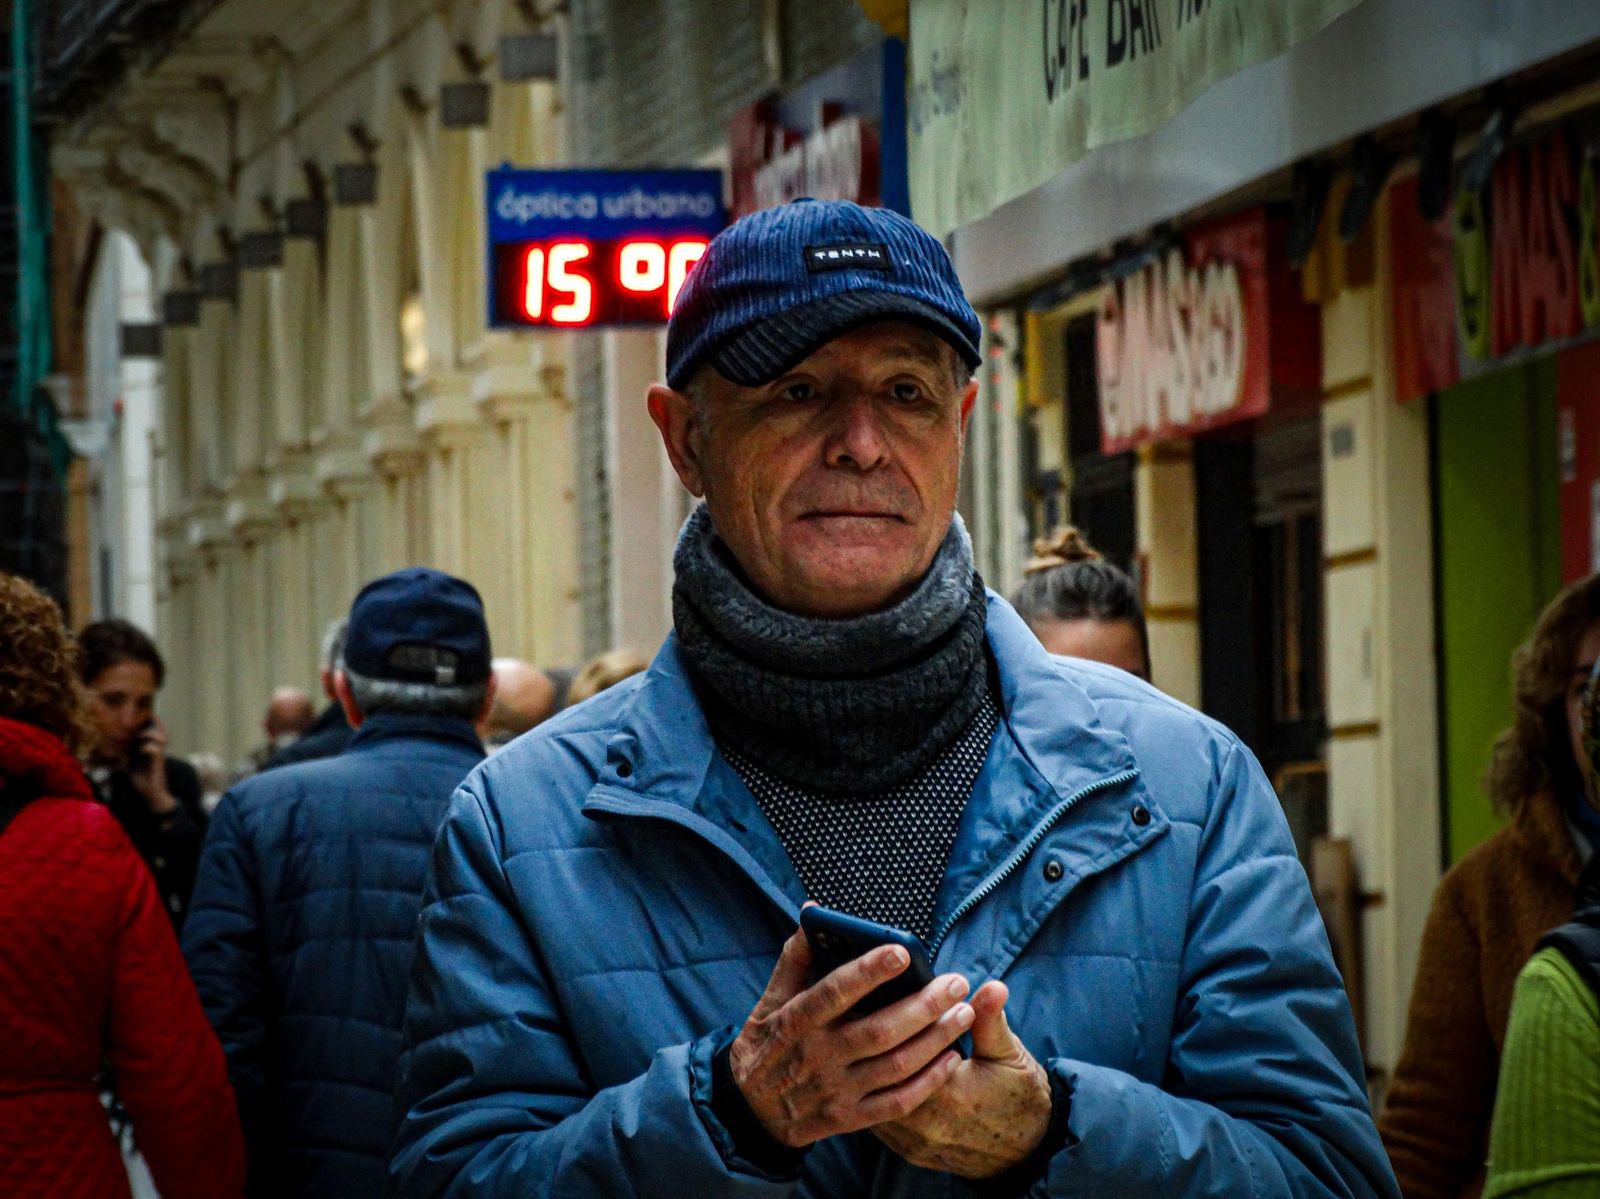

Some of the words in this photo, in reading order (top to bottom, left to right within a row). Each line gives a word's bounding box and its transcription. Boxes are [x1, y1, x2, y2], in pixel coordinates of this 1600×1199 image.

[497, 183, 598, 224] óptica
[814, 249, 880, 260] TENTH
[524, 242, 591, 322] 15
